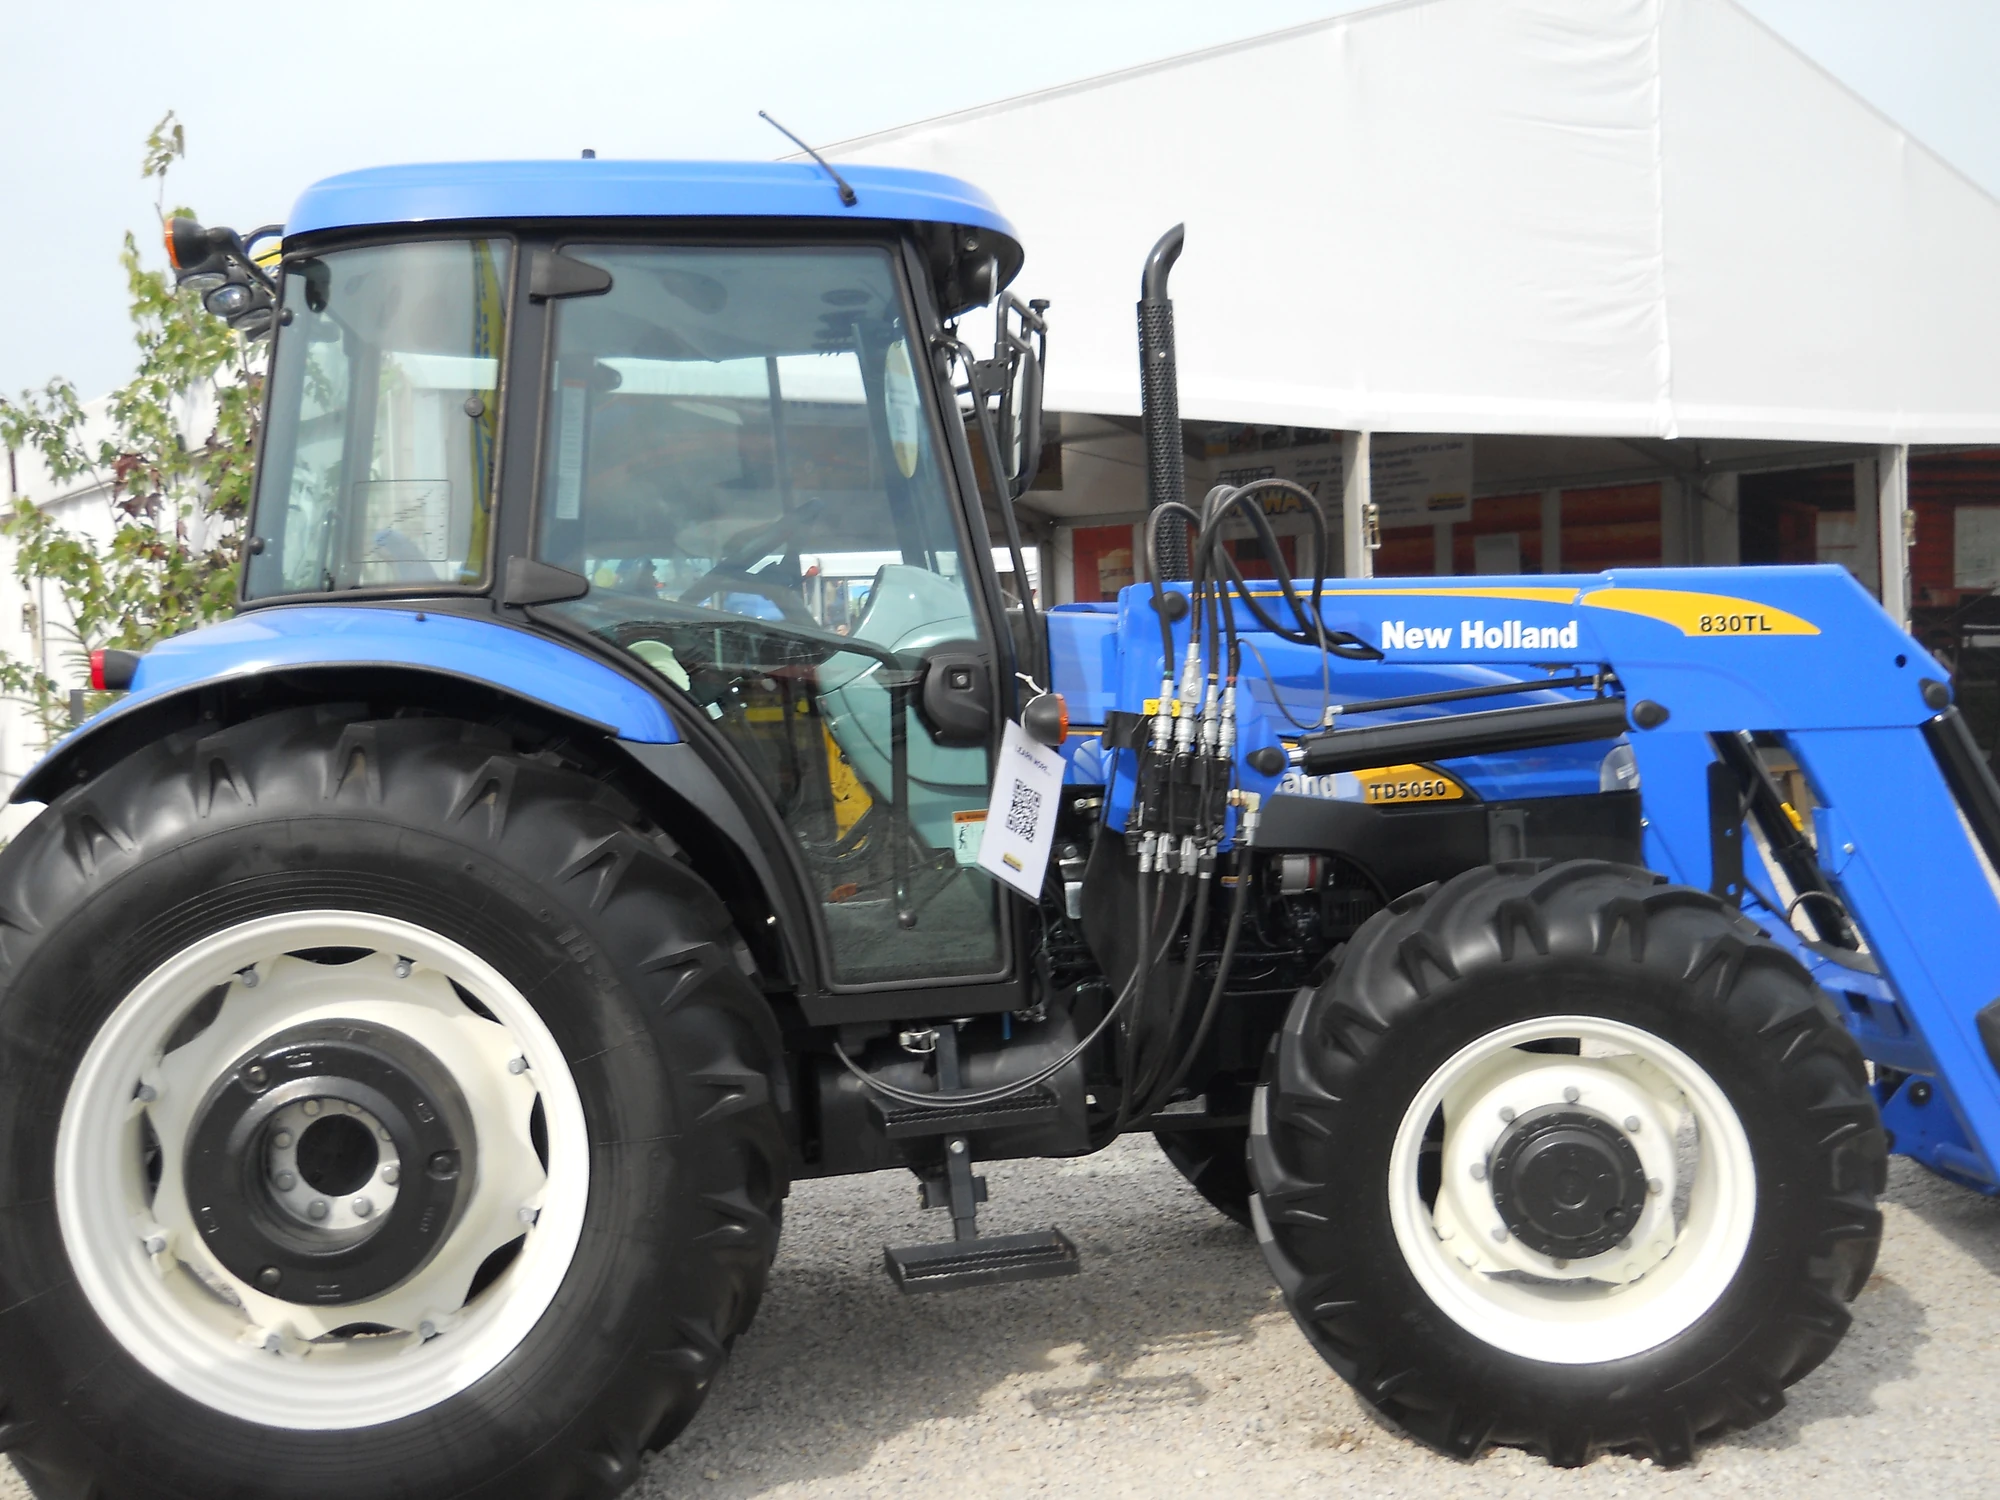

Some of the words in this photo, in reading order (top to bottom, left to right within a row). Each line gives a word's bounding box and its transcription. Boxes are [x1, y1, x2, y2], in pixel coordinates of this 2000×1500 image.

[1699, 614, 1773, 633] 830TL
[1381, 620, 1452, 650] New
[1460, 620, 1579, 650] Holland
[1368, 781, 1447, 800] TD5050
